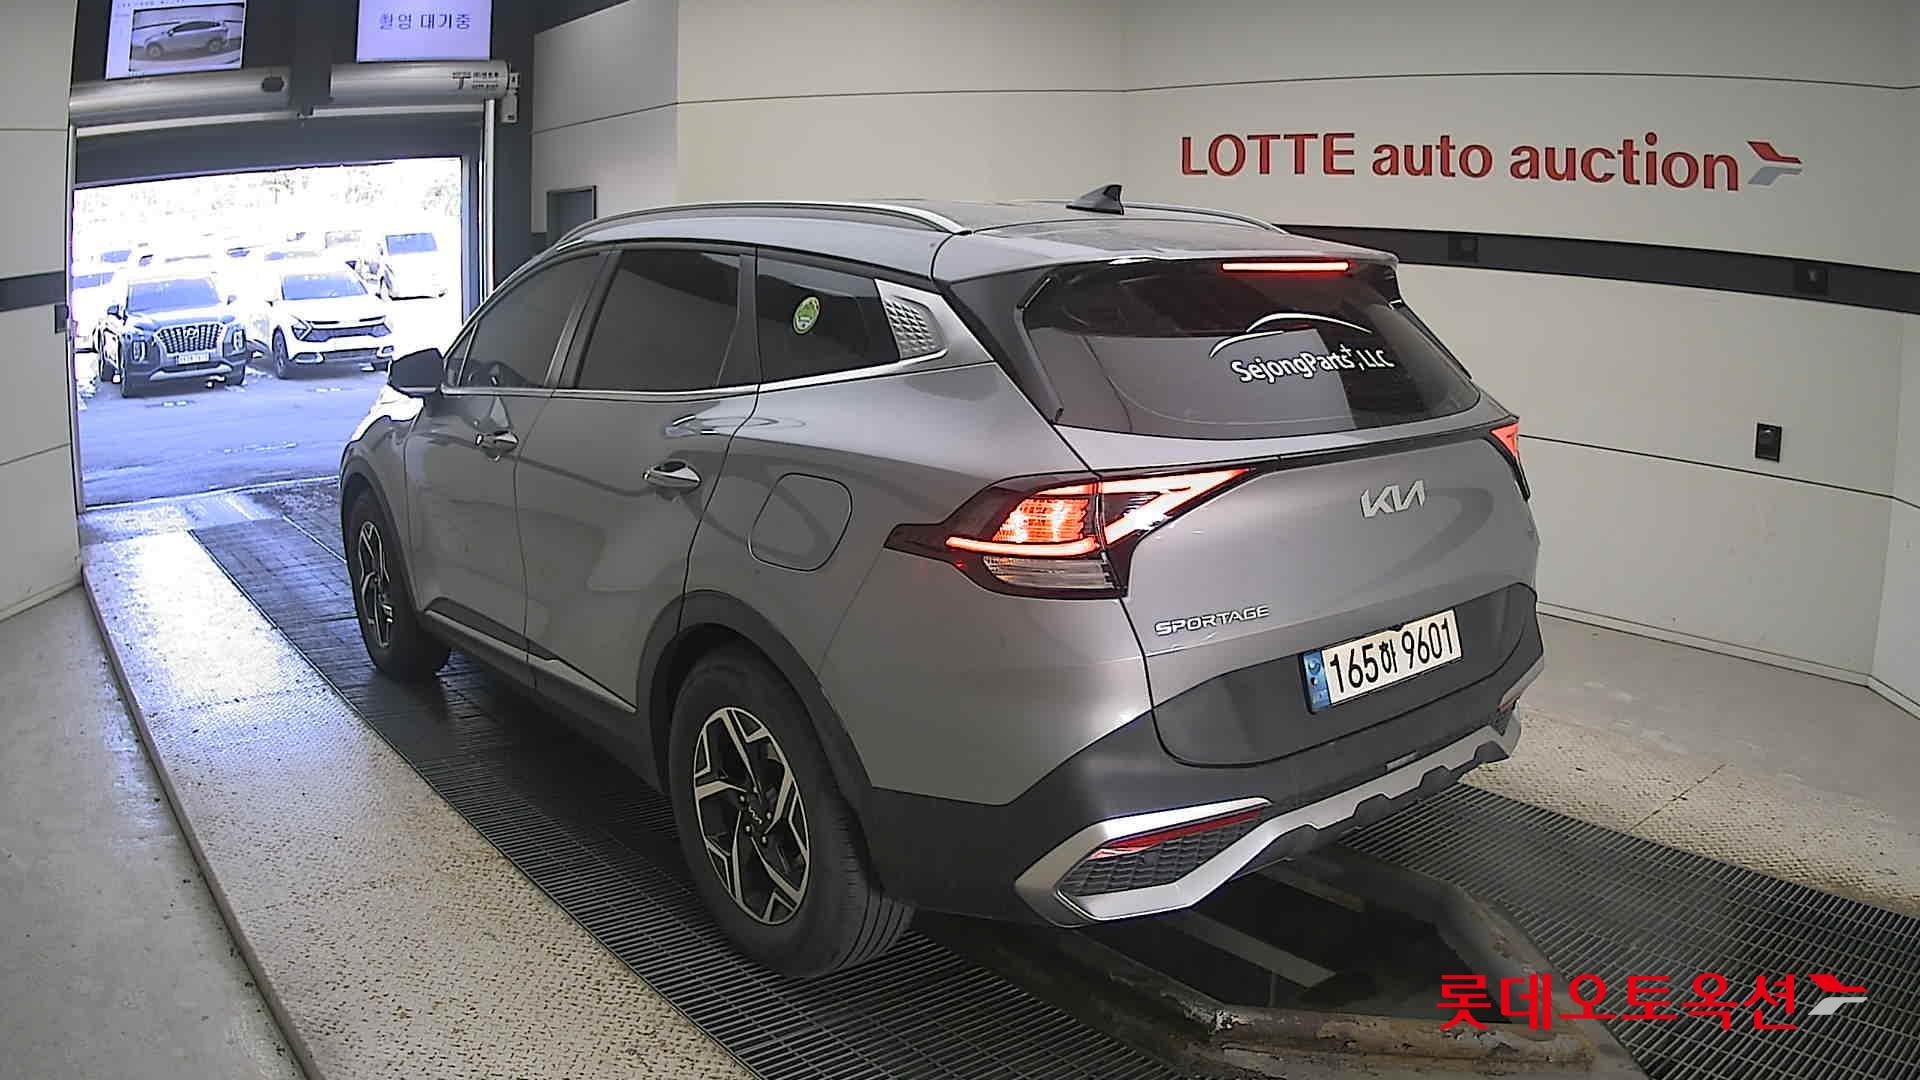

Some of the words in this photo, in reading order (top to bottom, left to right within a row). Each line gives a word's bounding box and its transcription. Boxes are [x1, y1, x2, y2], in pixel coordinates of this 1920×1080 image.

[420, 13, 472, 30] 대기중
[1182, 133, 1356, 177] LOTTE
[1372, 136, 1493, 178] auto
[1509, 132, 1739, 192] auction
[1360, 480, 1425, 518] KIA
[1155, 605, 1270, 636] SPORTAGE
[1401, 617, 1453, 669] 9601
